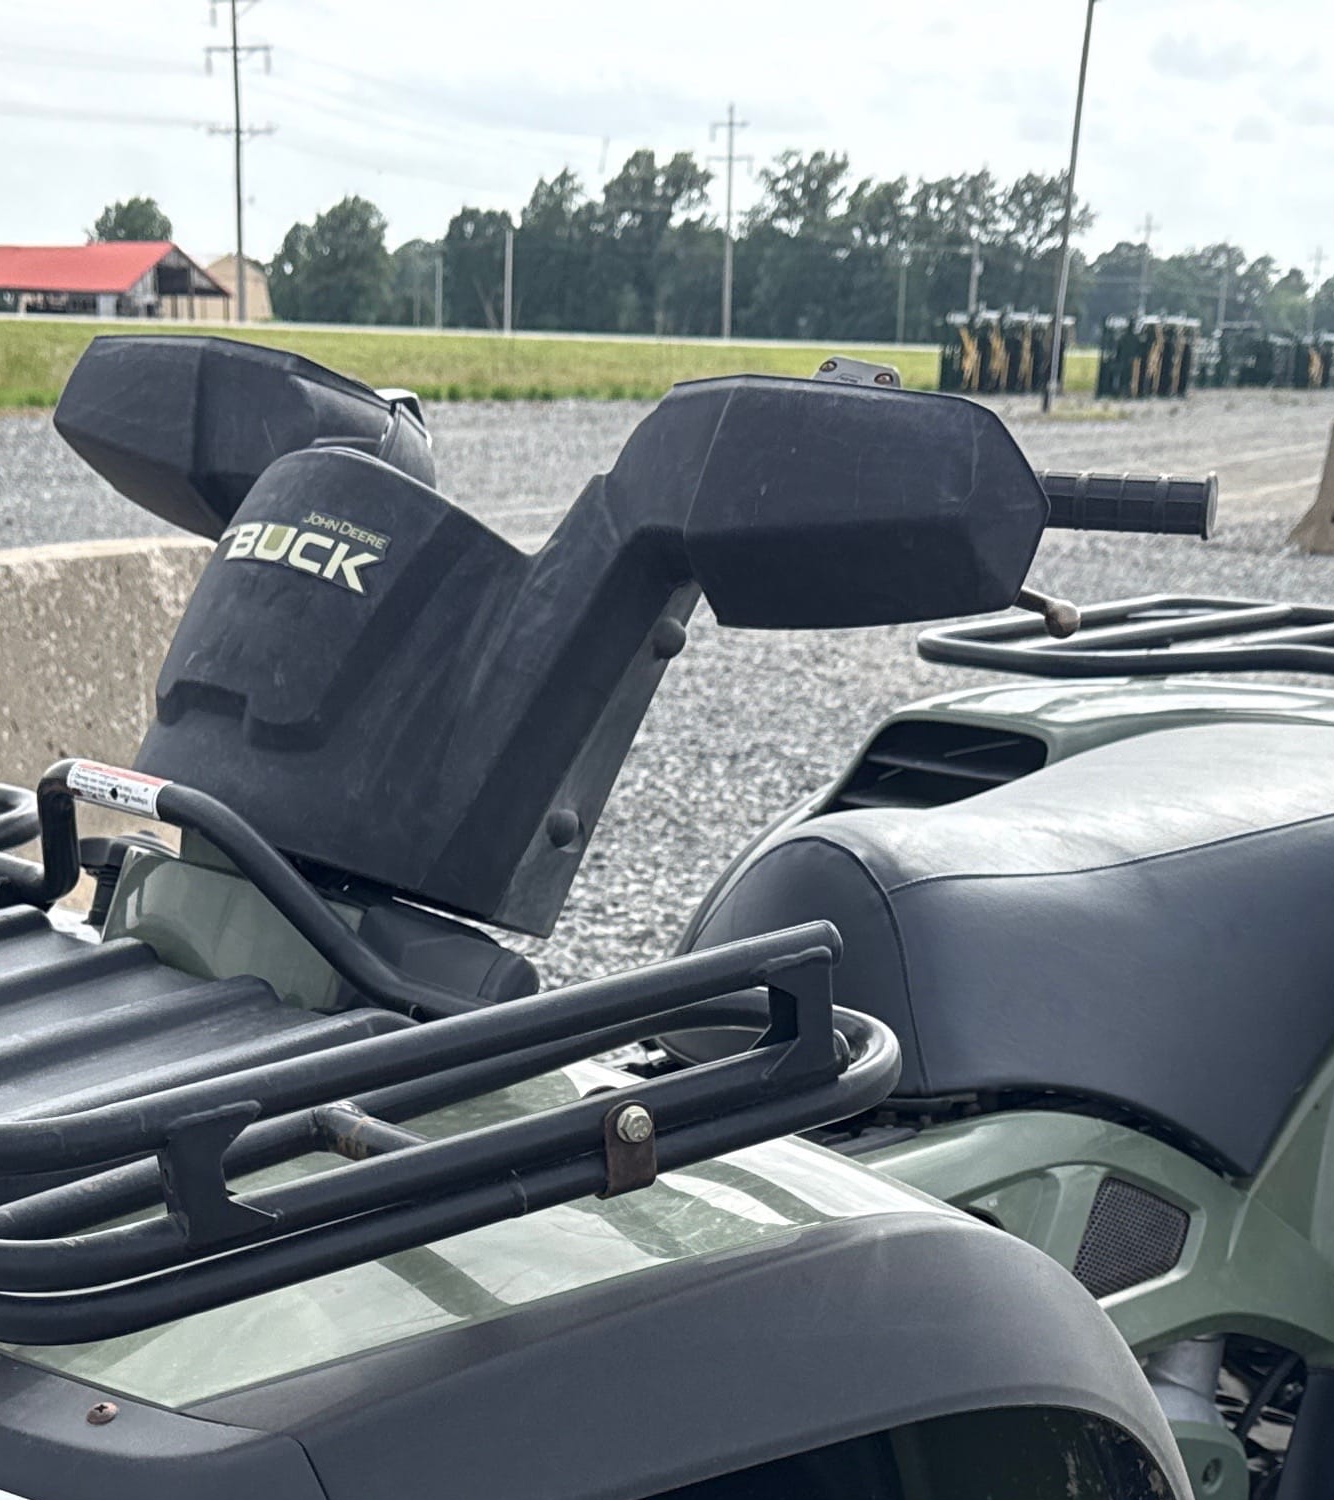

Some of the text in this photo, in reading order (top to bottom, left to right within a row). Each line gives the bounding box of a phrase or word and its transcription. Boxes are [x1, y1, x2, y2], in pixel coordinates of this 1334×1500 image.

[224, 522, 379, 594] BUCK
[303, 511, 387, 550] JOHN DEERE
